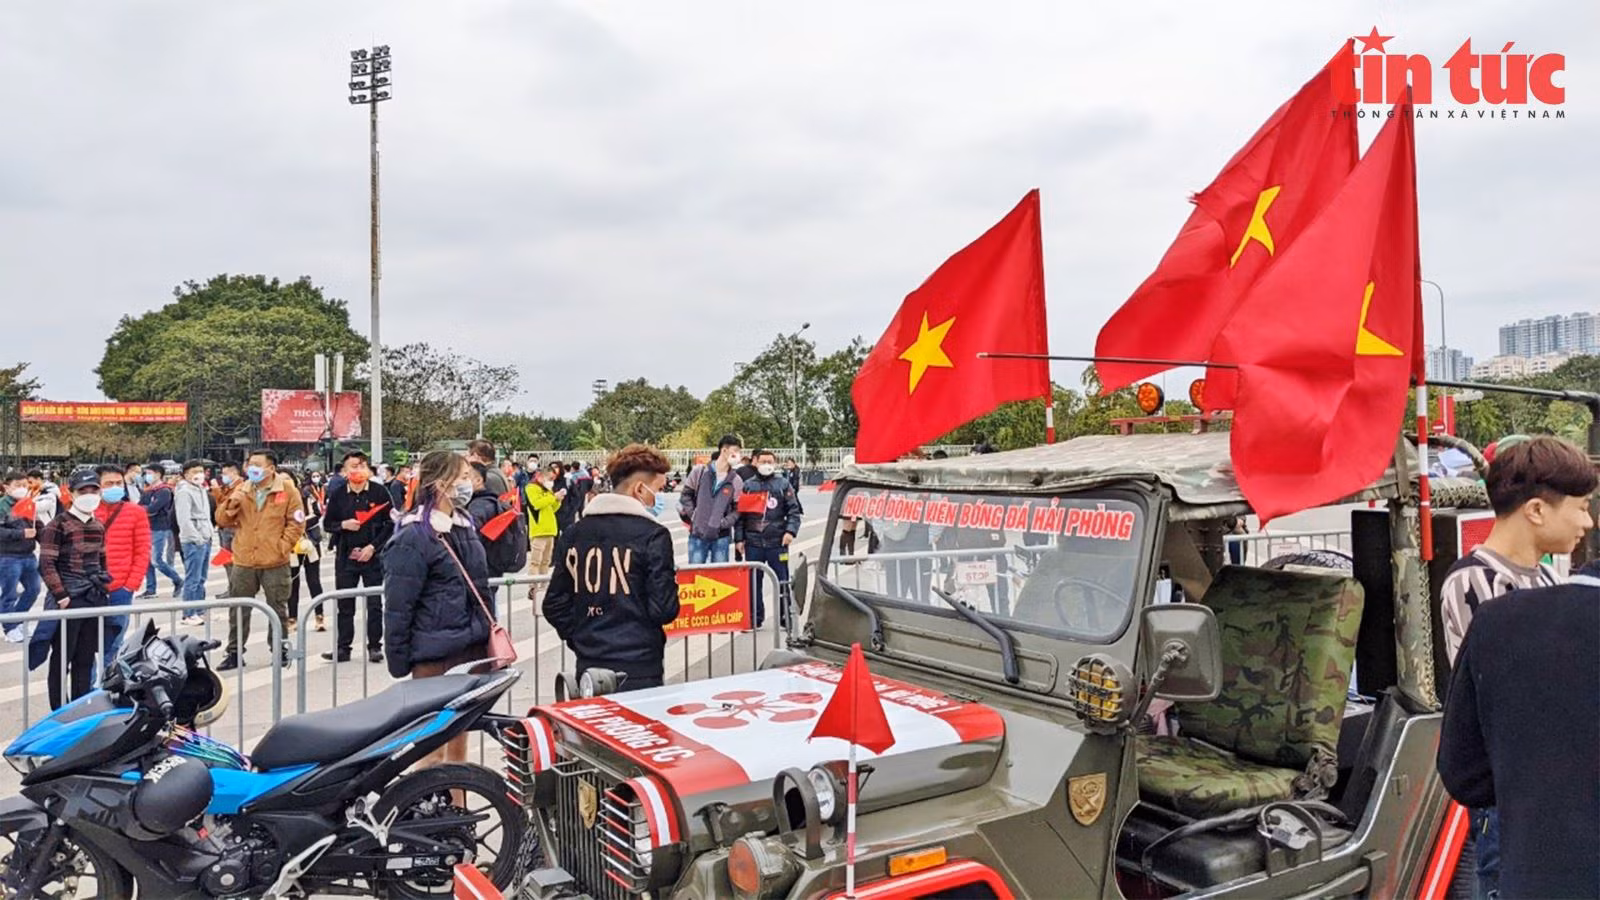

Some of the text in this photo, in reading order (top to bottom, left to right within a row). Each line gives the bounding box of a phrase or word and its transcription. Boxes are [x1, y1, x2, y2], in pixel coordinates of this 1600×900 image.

[923, 496, 960, 528] VIÊN
[1003, 500, 1031, 532] ĐÁ
[1030, 497, 1066, 534] HẢI
[1064, 503, 1136, 540] PHÒNG
